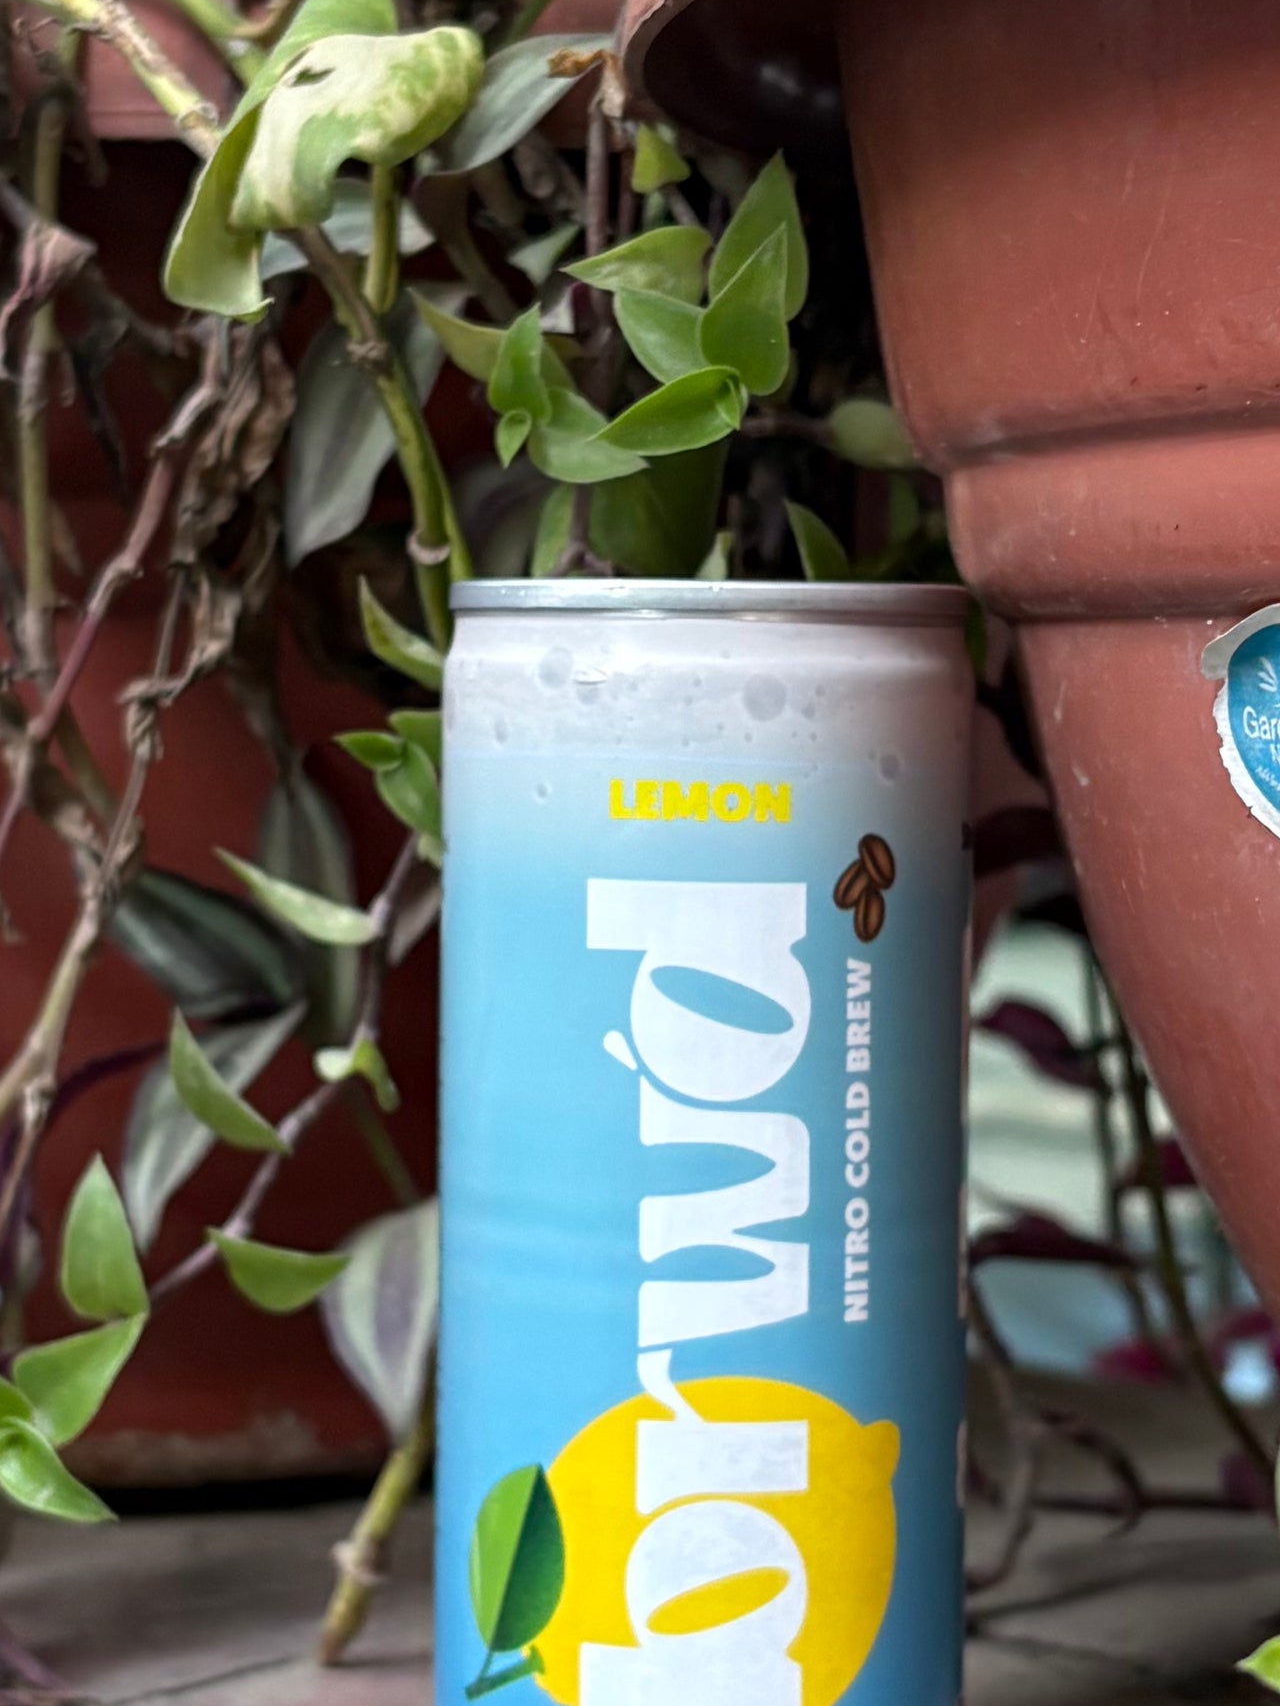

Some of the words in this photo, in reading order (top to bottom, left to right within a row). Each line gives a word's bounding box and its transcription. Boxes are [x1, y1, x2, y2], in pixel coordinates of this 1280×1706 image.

[608, 778, 792, 823] LEMON
[845, 957, 872, 1073] BREW
[844, 1080, 870, 1189] COLD
[843, 1196, 869, 1324] NITRO
